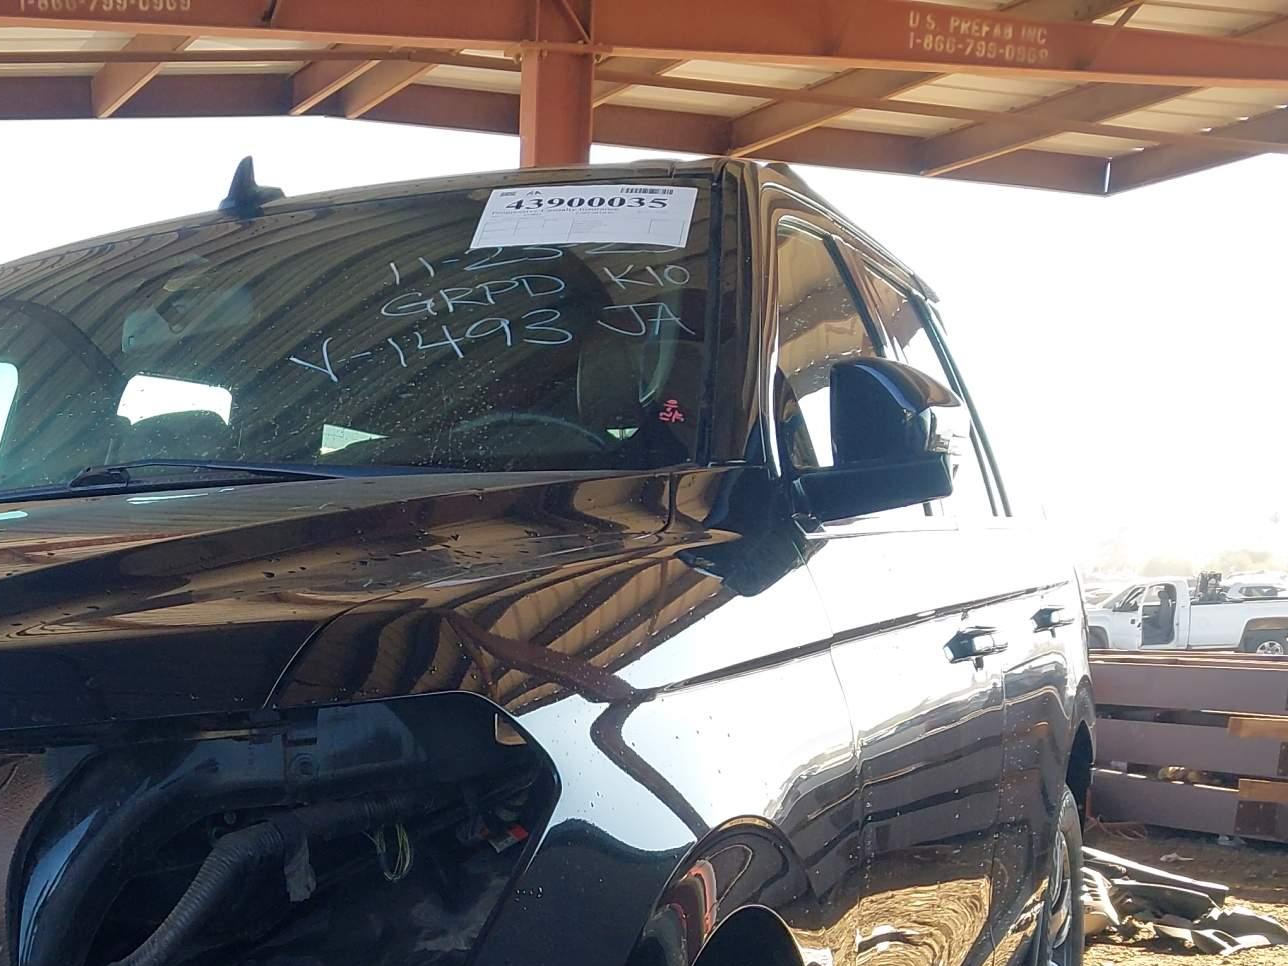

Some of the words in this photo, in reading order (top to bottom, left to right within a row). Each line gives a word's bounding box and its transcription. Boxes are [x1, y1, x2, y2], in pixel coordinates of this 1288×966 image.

[949, 17, 1013, 40] PREFAB
[505, 197, 668, 210] 43900035
[380, 274, 566, 317] GRPD
